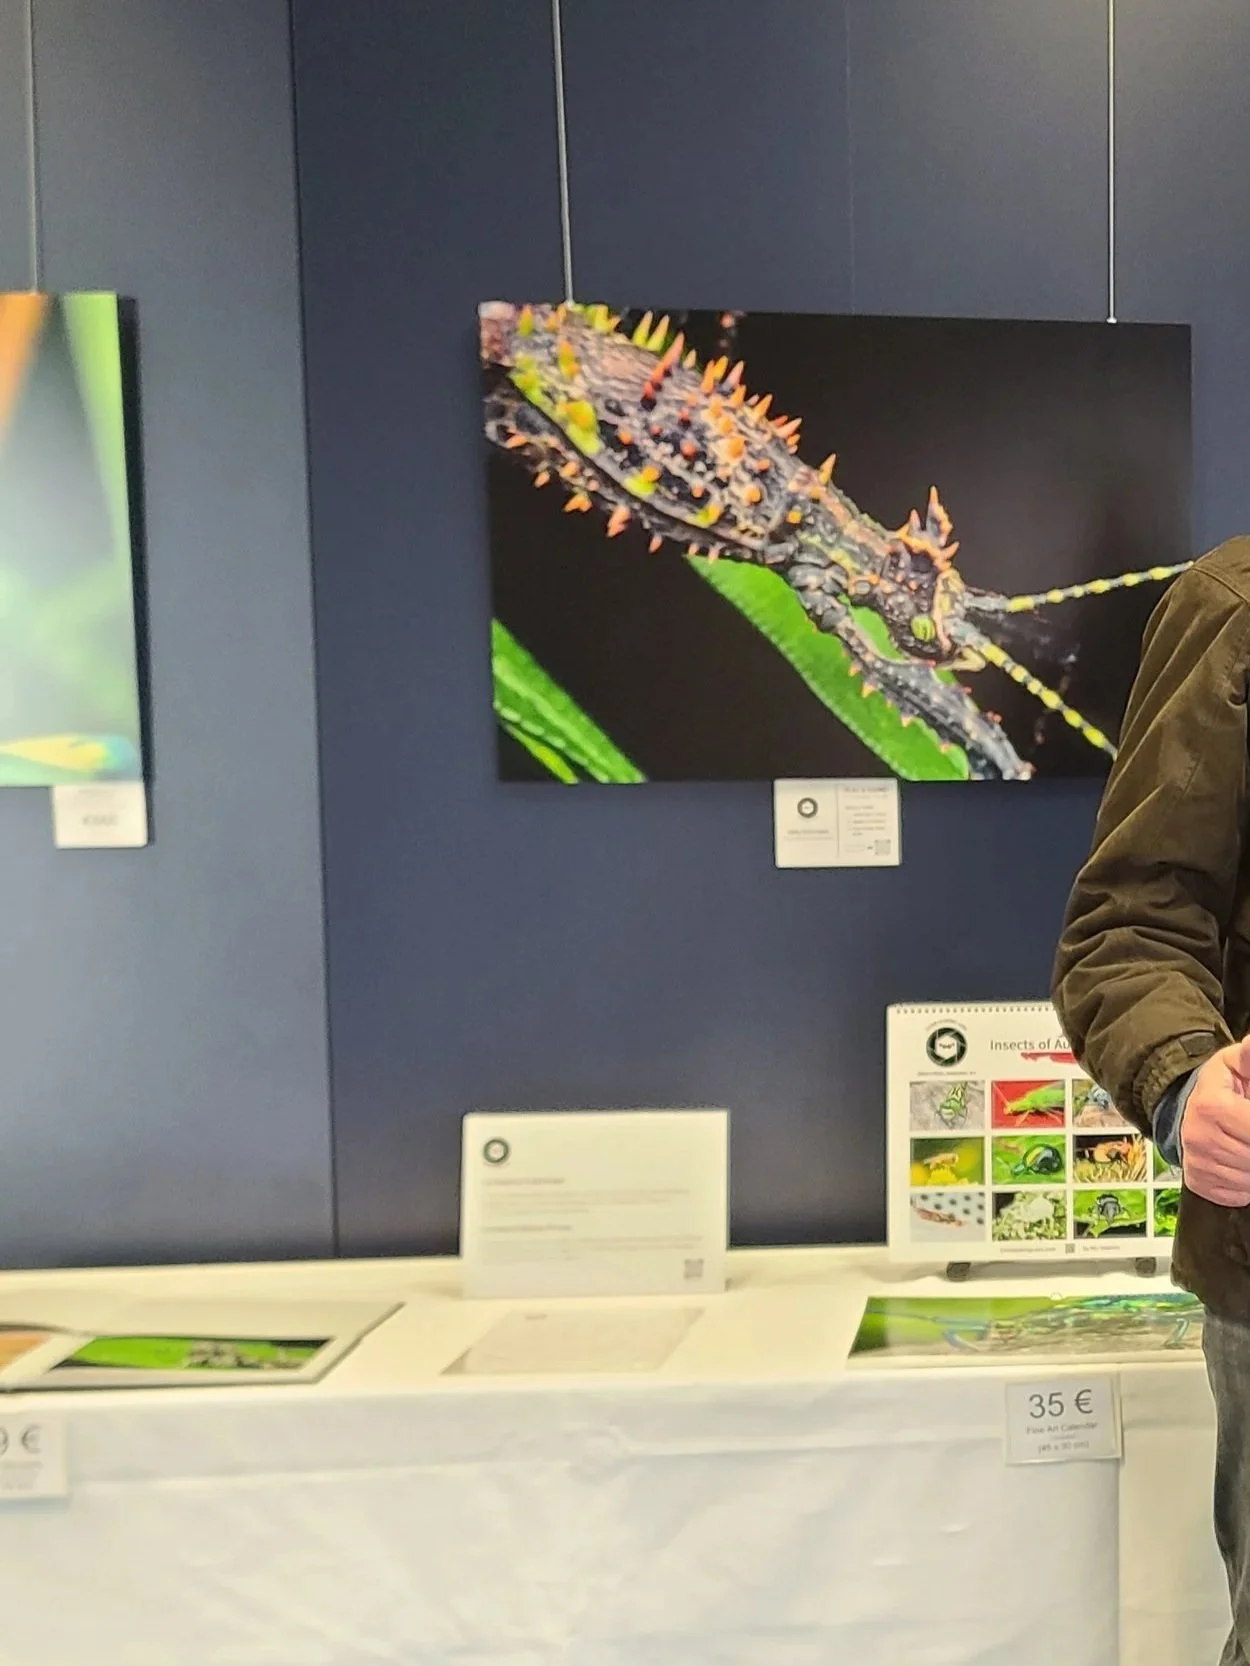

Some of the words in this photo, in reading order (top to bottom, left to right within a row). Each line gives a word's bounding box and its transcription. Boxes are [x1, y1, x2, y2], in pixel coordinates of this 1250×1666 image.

[989, 1039, 1035, 1051] Insects
[1038, 1038, 1052, 1050] of
[1028, 1391, 1065, 1419] 35
[1073, 1388, 1093, 1415] €
[20, 1422, 43, 1455] €
